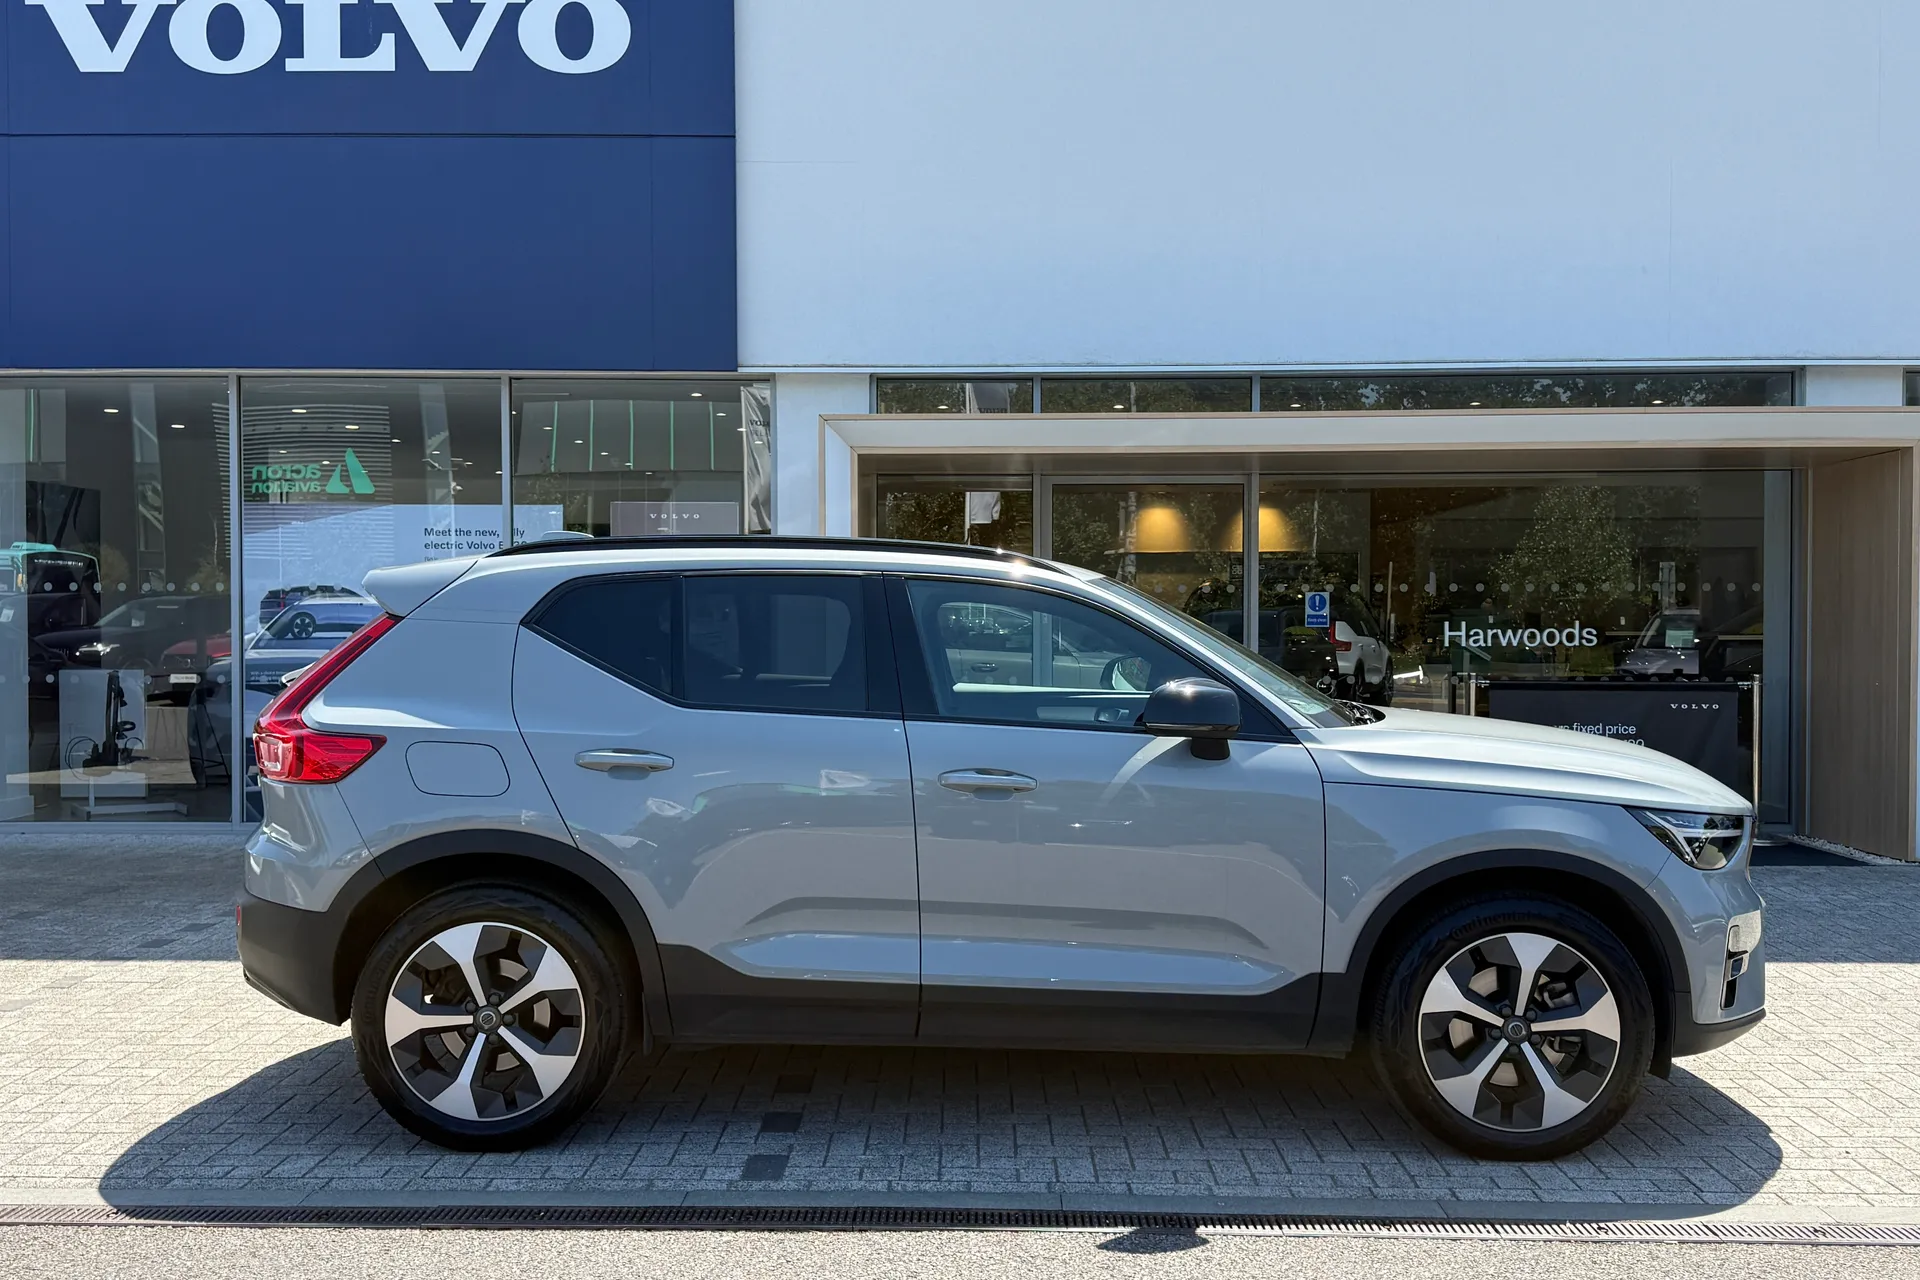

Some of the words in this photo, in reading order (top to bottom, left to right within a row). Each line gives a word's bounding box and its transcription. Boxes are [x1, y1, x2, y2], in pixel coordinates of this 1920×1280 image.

[24, 0, 632, 75] VOLVO
[424, 528, 452, 537] Meet
[455, 528, 471, 537] the
[475, 529, 500, 538] new,
[424, 541, 463, 550] electric
[466, 541, 495, 550] Volvo
[1443, 620, 1598, 648] Harwoods
[1573, 722, 1603, 735] fixed
[1606, 723, 1636, 737] price
